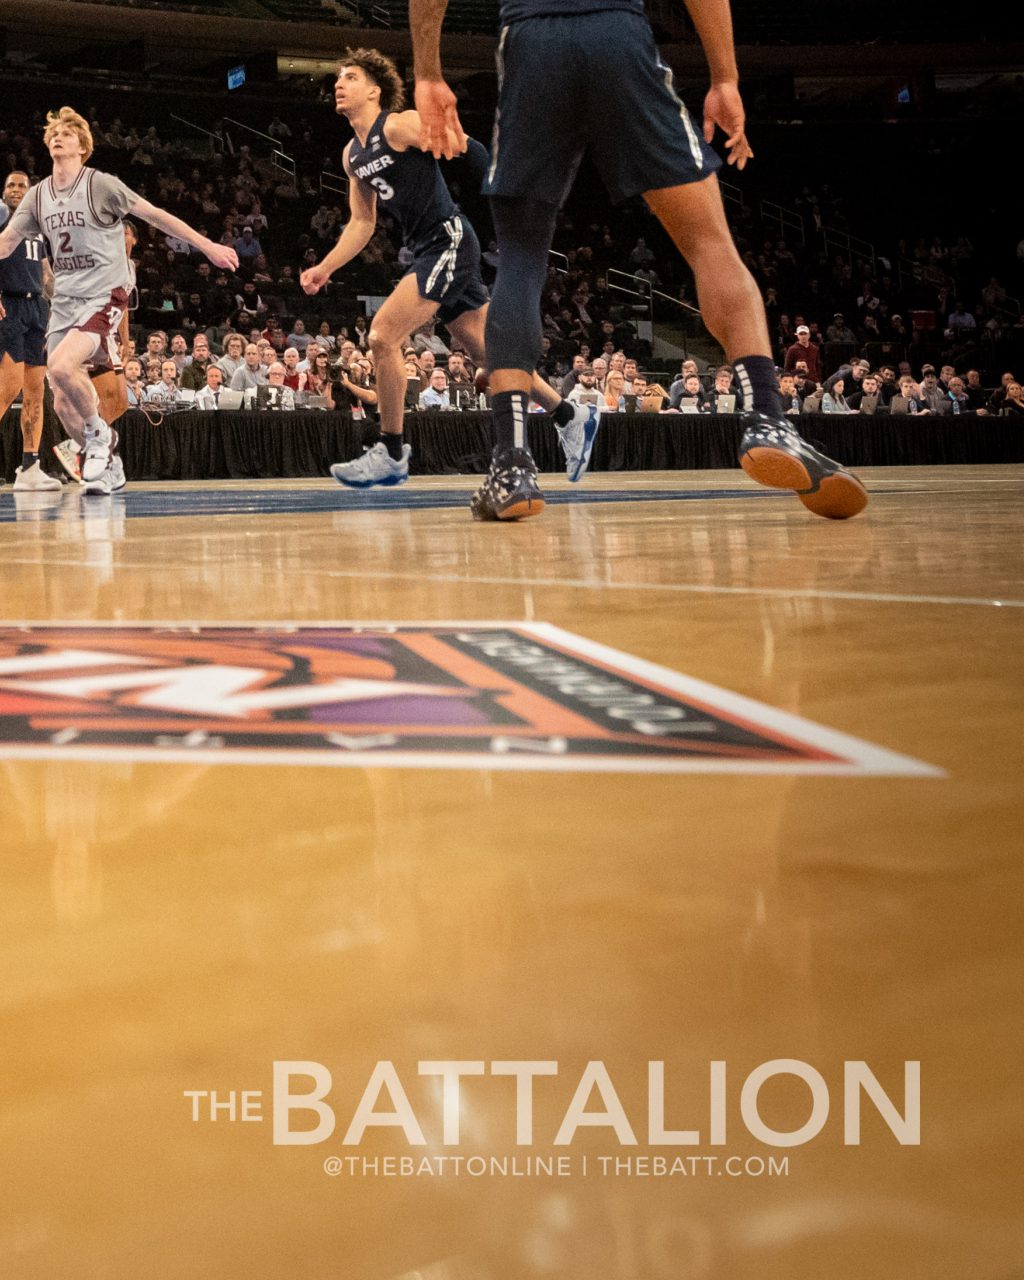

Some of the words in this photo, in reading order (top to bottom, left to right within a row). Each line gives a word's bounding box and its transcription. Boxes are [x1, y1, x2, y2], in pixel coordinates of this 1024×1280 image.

[370, 176, 395, 201] 3
[44, 210, 86, 233] TEXAS
[25, 239, 39, 262] 11
[59, 231, 74, 253] 2
